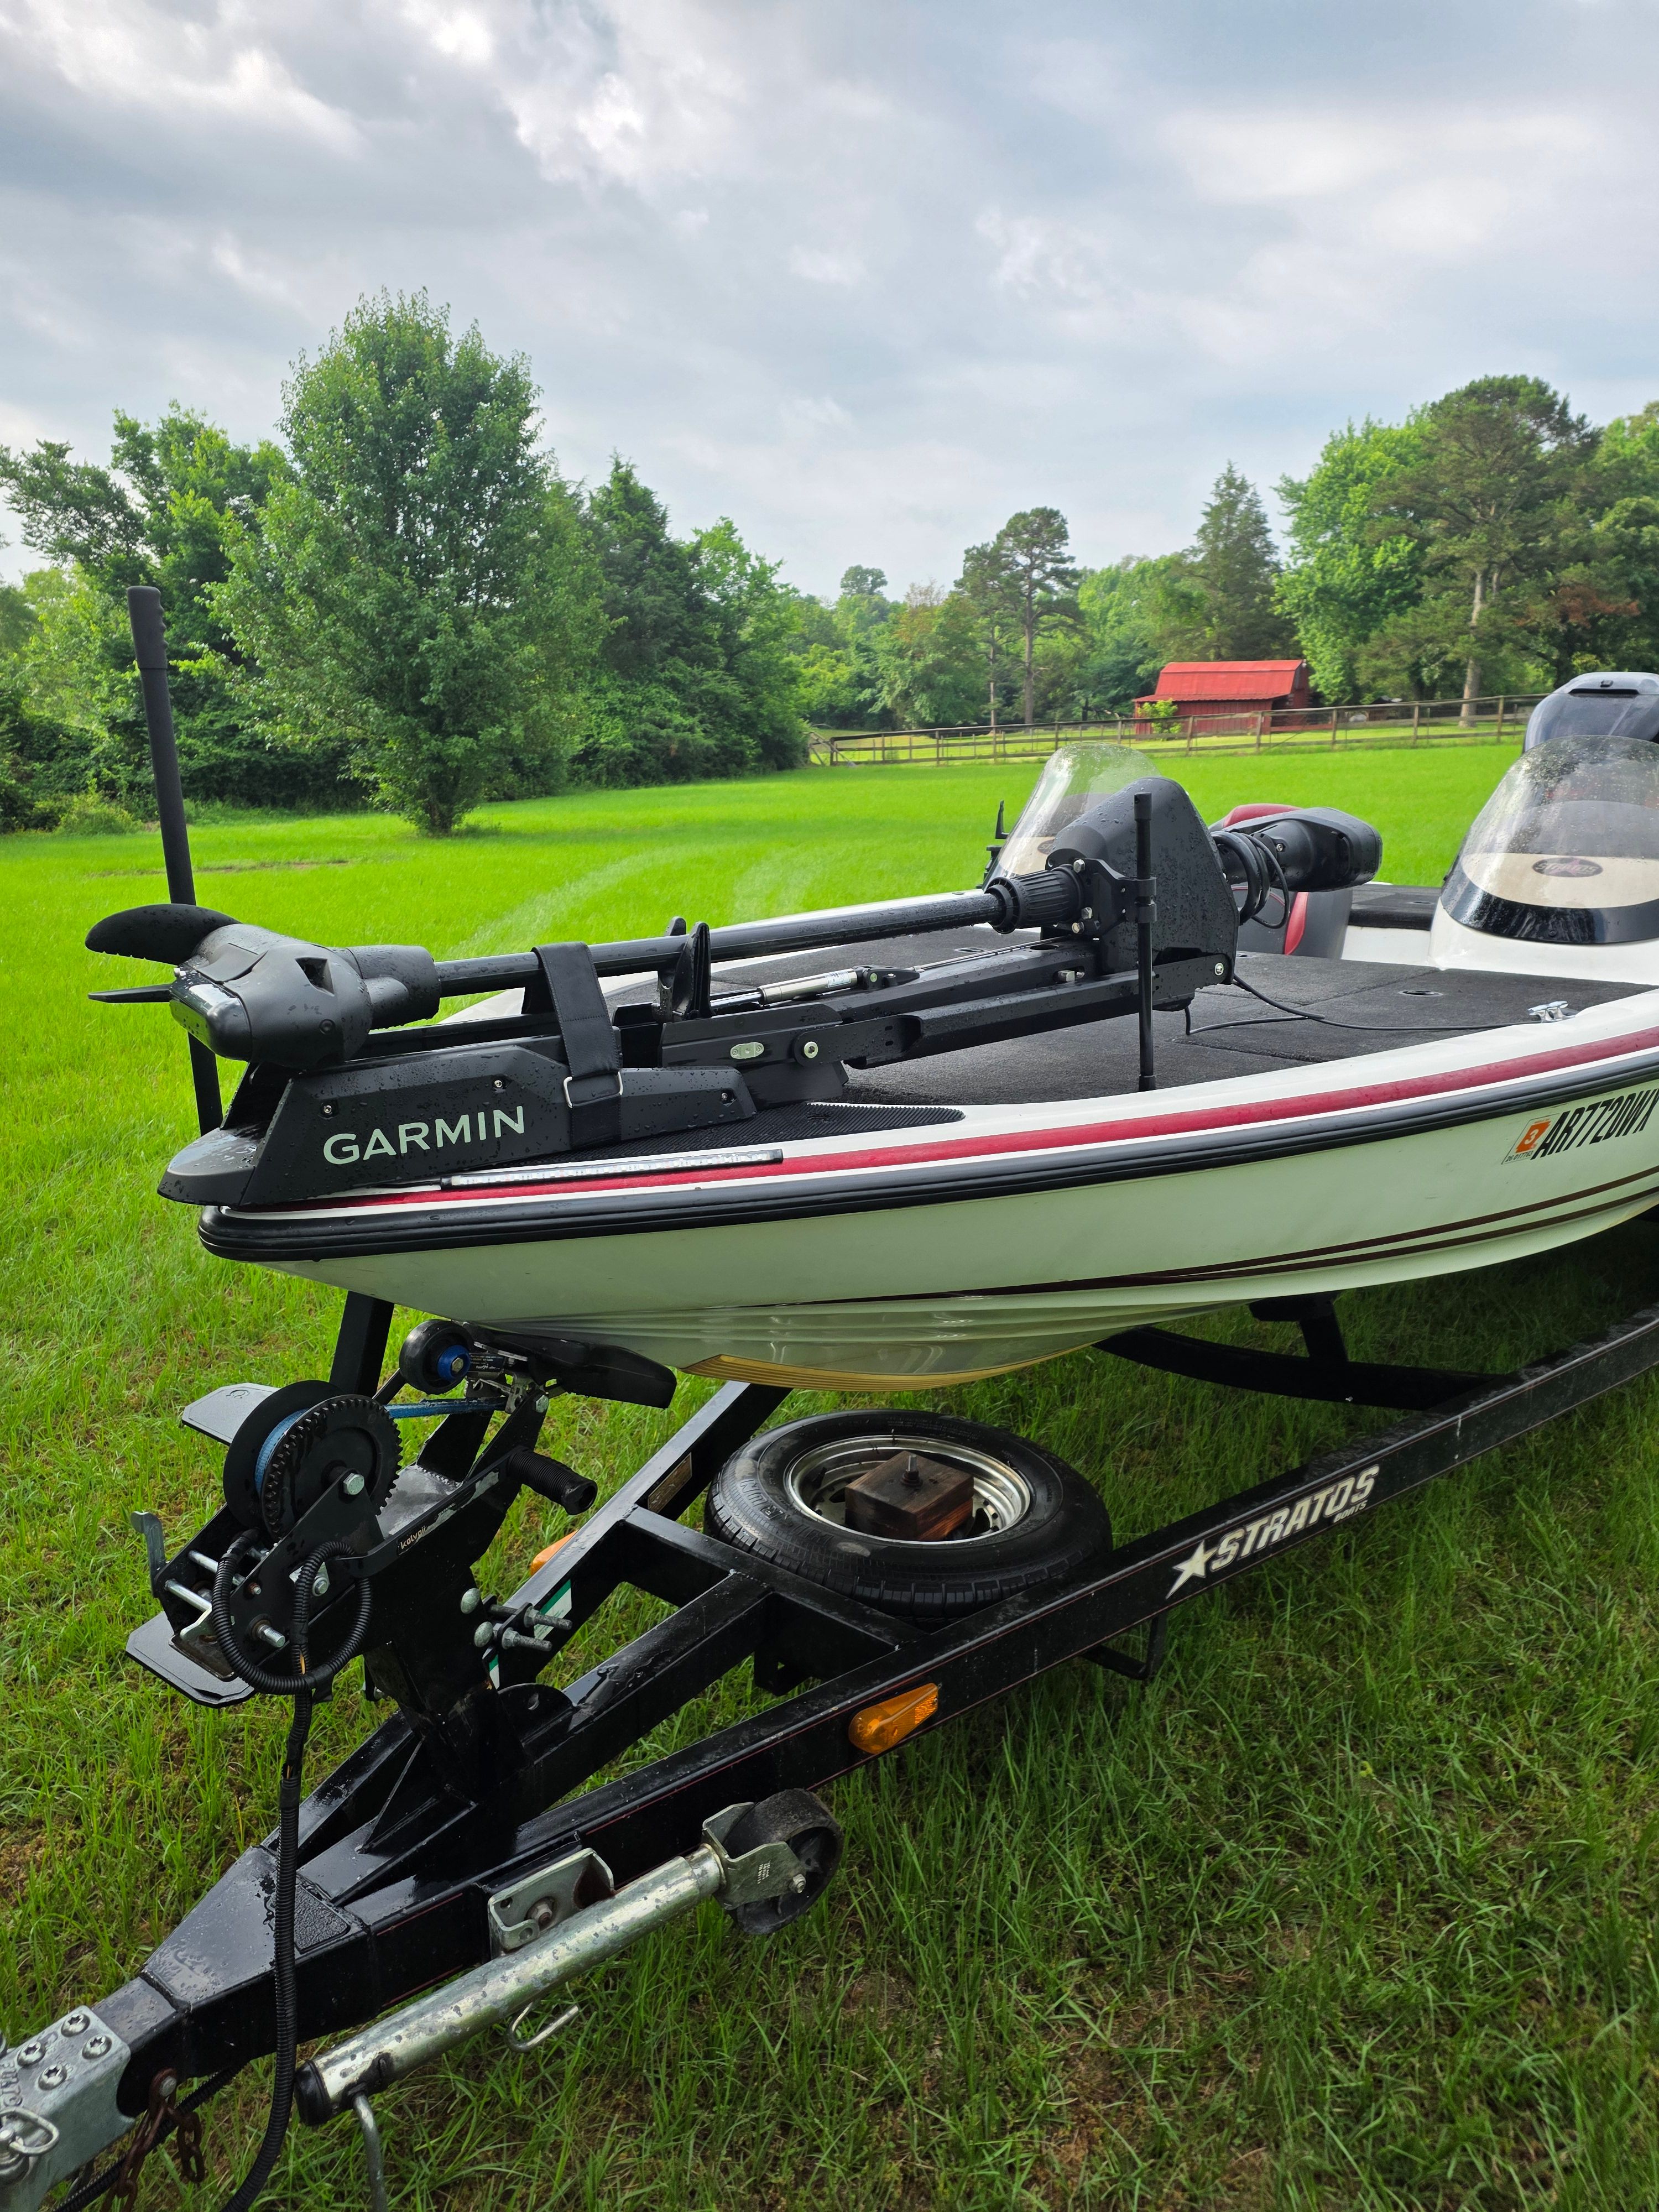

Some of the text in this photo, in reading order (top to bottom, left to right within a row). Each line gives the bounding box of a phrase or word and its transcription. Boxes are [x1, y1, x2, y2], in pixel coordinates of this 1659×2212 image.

[323, 1105, 525, 1165] GARMIN
[1524, 1129, 1539, 1145] 3
[1210, 1464, 1380, 1572] STRATOS
[1333, 1500, 1368, 1523] BOATS
